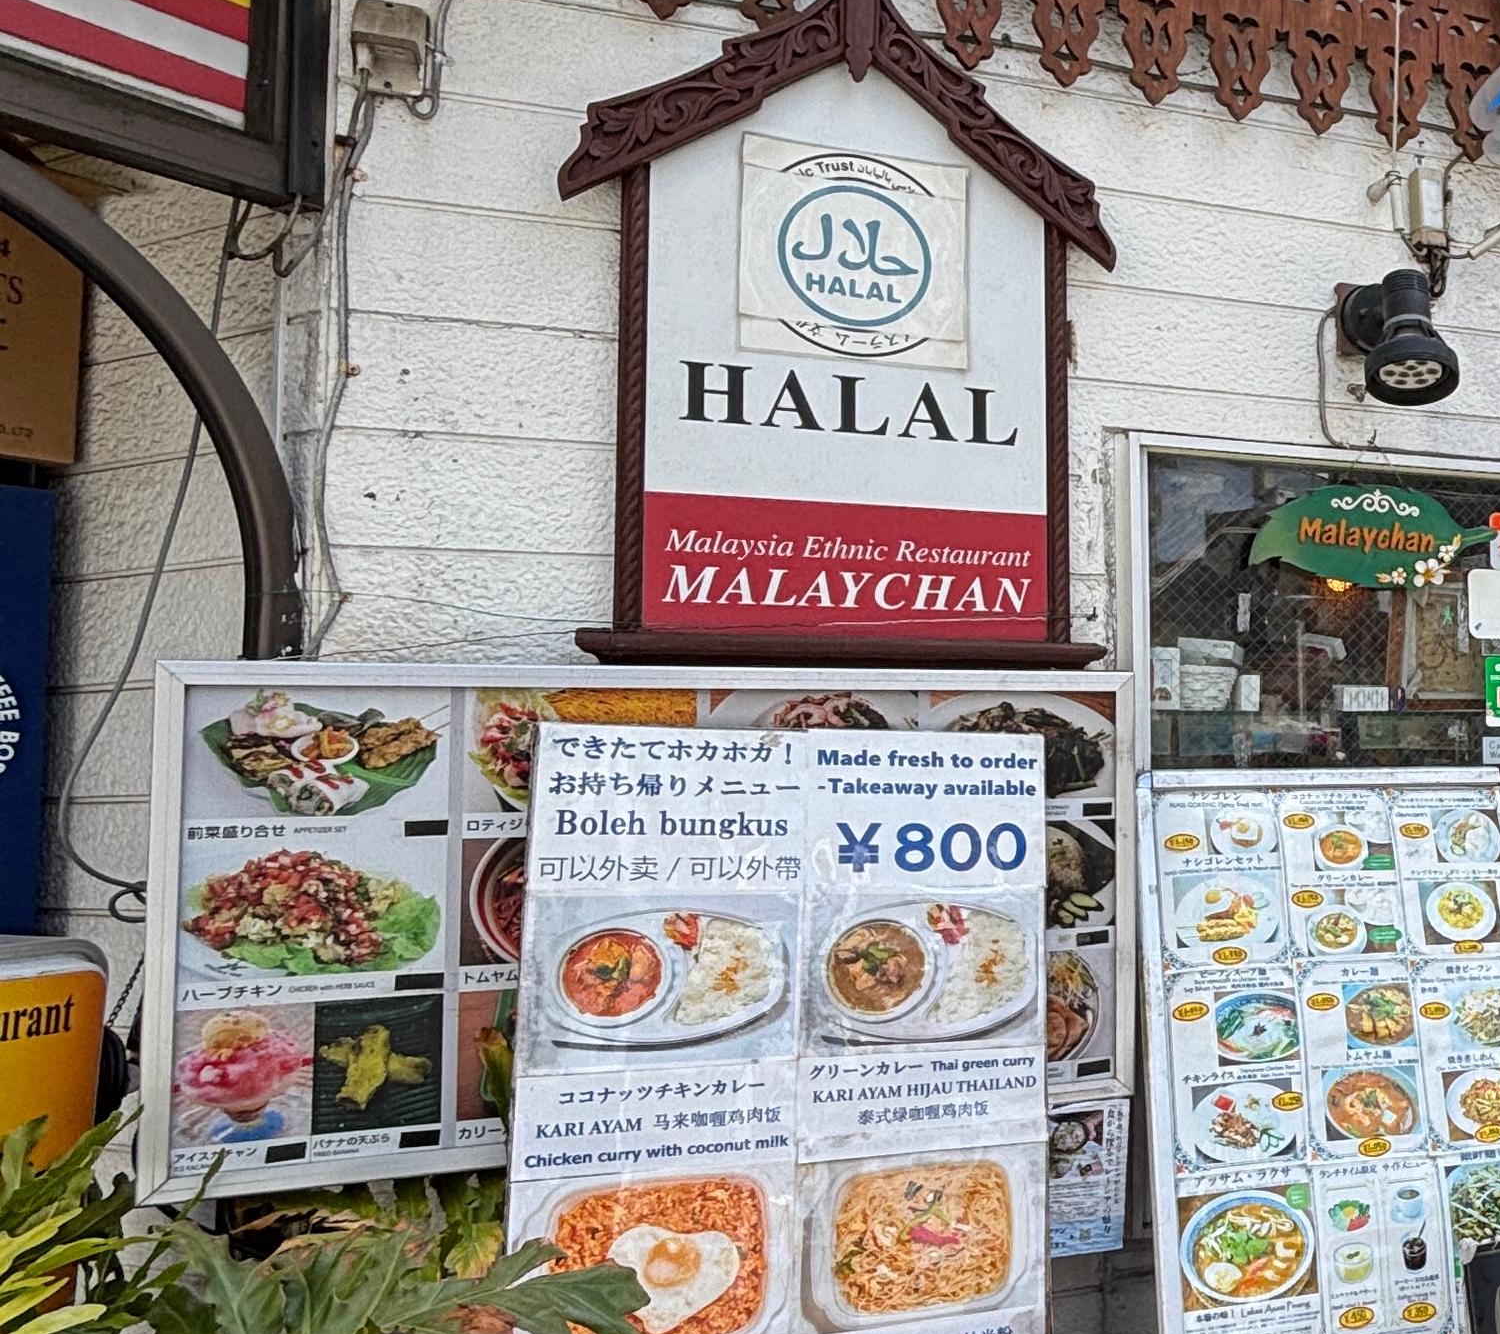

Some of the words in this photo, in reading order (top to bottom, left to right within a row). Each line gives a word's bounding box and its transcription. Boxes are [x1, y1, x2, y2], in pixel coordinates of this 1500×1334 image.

[815, 160, 854, 174] Trust
[791, 212, 919, 276] حلال
[805, 271, 902, 304] HALAL
[679, 359, 1020, 448] HALAL
[665, 528, 794, 561] Malaysia
[802, 536, 888, 562] Ethnic
[896, 539, 1032, 568] Restaurant
[1299, 516, 1436, 554] Malaychan
[662, 564, 1032, 614] MALAYCHAN
[552, 734, 793, 766] できたてホカホカ！
[817, 749, 881, 768] Made
[888, 749, 944, 769] fresh
[950, 751, 974, 769] to
[980, 752, 1038, 771] order
[549, 771, 801, 799] お持ち帰りメニュー
[943, 779, 1037, 798] available
[187, 825, 287, 840] 前菜盛り合せ
[467, 818, 523, 832] ロティジ
[556, 810, 647, 838] Boleh
[660, 811, 789, 840] bungkus
[539, 856, 658, 882] 可以外卖
[182, 984, 283, 1002] ハーブチキン
[808, 1061, 924, 1081] グリーンカレー
[931, 1058, 959, 1073] Thai
[962, 1058, 999, 1075] green
[1002, 1055, 1036, 1072] curry
[1182, 1070, 1235, 1085] チキンライス
[558, 1079, 766, 1107] ココナッツチキンカレー
[812, 1087, 854, 1104] KARI
[856, 1084, 902, 1101] AYAM
[906, 1080, 954, 1097] HIJAU
[956, 1074, 1037, 1094] THAILAND
[458, 1126, 508, 1141] カリー
[535, 1120, 584, 1140] KARI
[588, 1115, 643, 1136] AYAM
[653, 1107, 782, 1132] 马来咖喱鸡肉饭
[312, 1133, 391, 1150] バナナの天ぷら
[524, 1150, 593, 1170] Chicken
[597, 1146, 642, 1167] curry
[645, 1140, 682, 1159] with
[687, 1137, 750, 1156] coconut
[755, 1134, 790, 1150] milk
